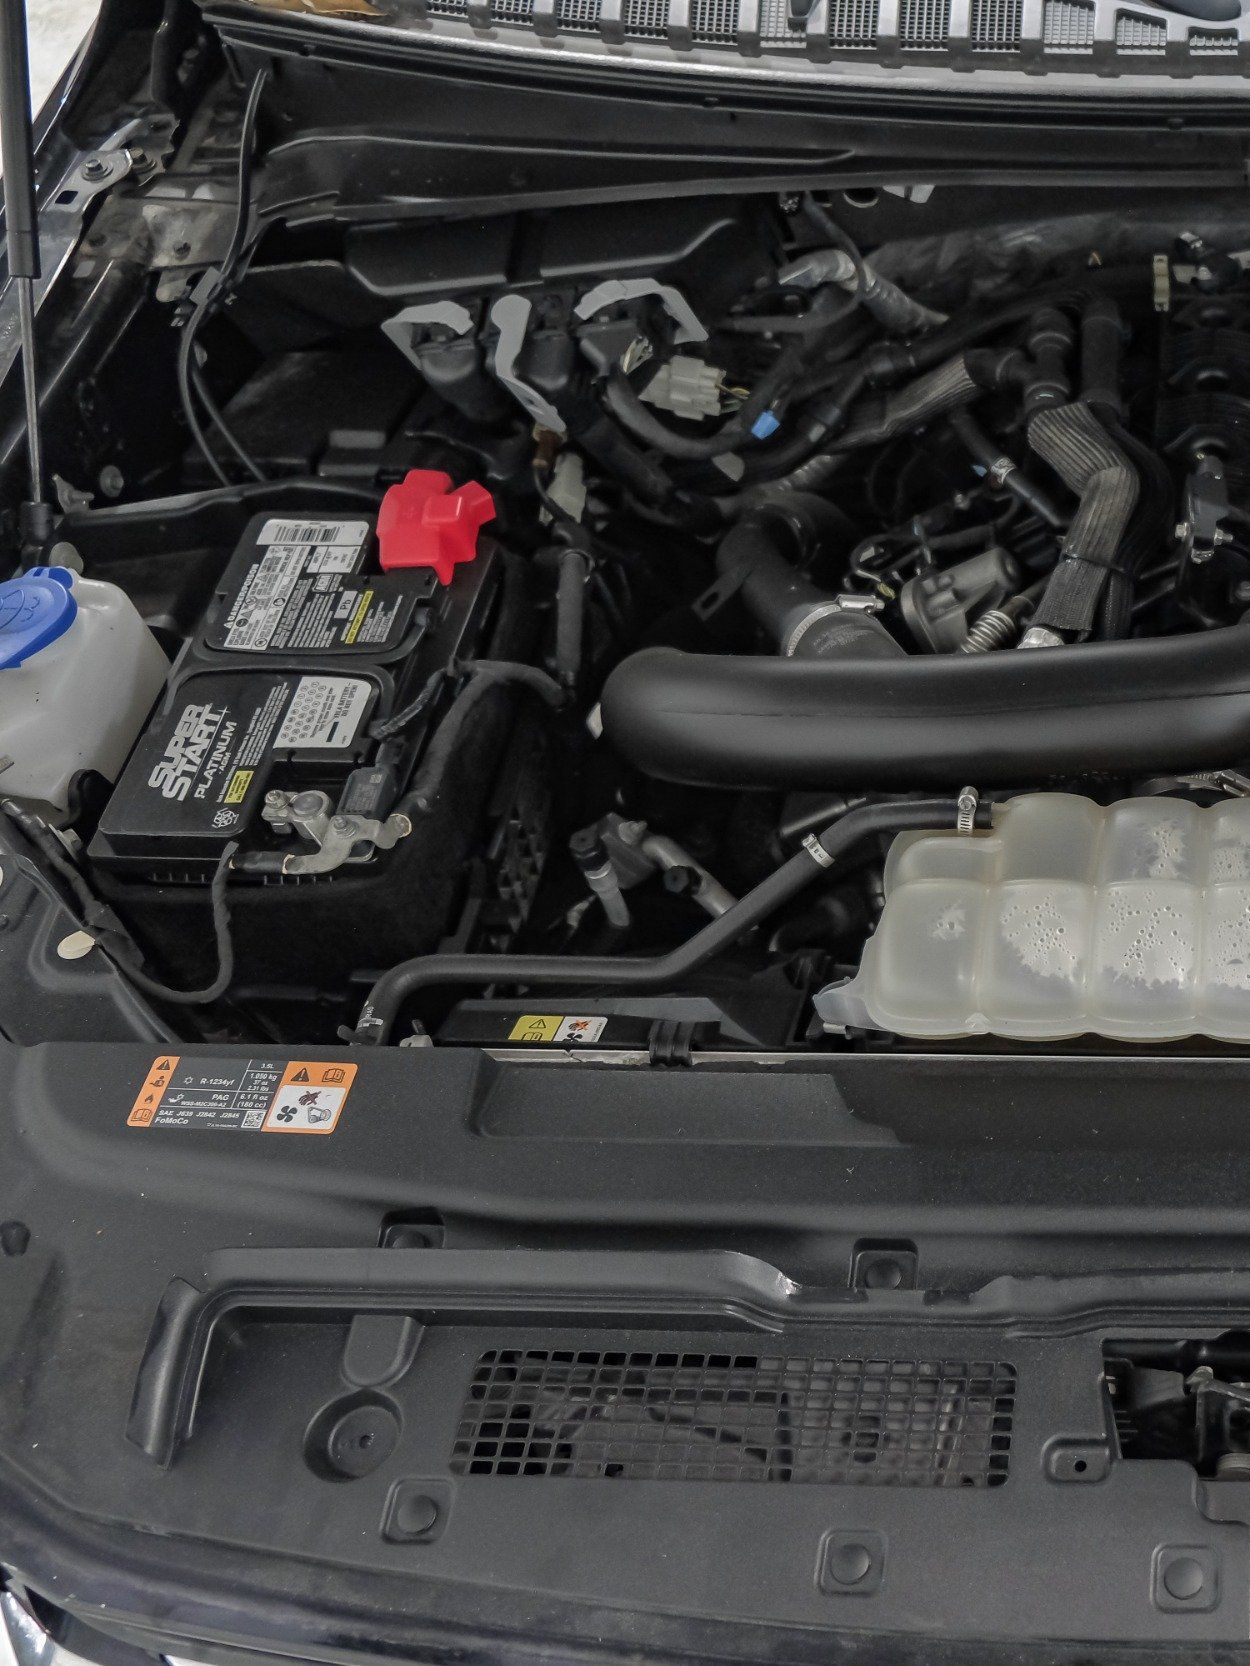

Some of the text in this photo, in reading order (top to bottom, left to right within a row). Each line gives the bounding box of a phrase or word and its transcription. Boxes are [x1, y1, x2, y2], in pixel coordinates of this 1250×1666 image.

[340, 599, 352, 610] Pb
[148, 704, 204, 788] SUPER
[162, 702, 221, 801] START
[193, 721, 238, 799] PLATINUM
[200, 1077, 235, 1086] R-1234yf
[268, 1073, 278, 1081] kg
[154, 1116, 189, 1125] FoMoCo
